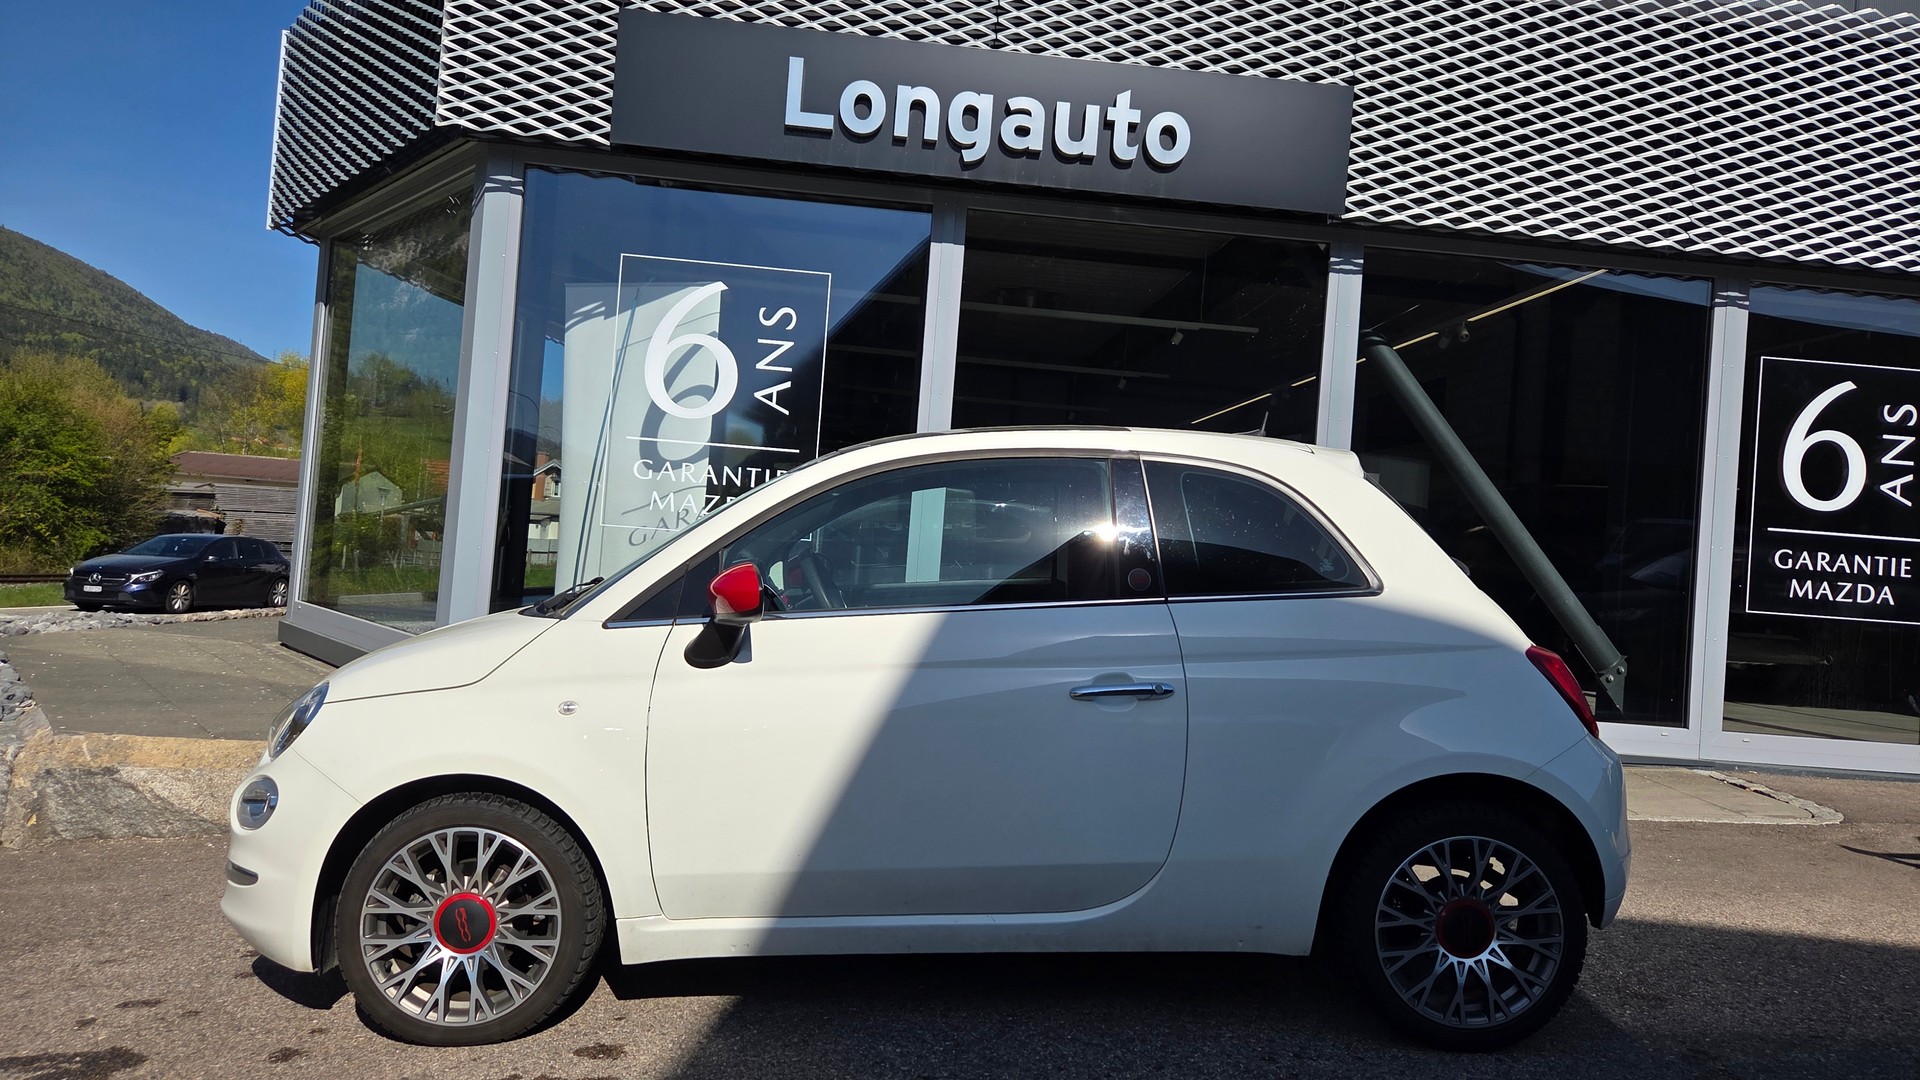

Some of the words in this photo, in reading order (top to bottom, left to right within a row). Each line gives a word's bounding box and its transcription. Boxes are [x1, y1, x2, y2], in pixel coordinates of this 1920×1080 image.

[785, 56, 1191, 165] Longauto
[645, 281, 738, 419] 6
[753, 306, 797, 416] ANS
[1783, 380, 1867, 512] 6
[1880, 404, 1917, 507] ANS
[1774, 549, 1912, 578] GARANTIE
[1790, 579, 1895, 606] MAZDA
